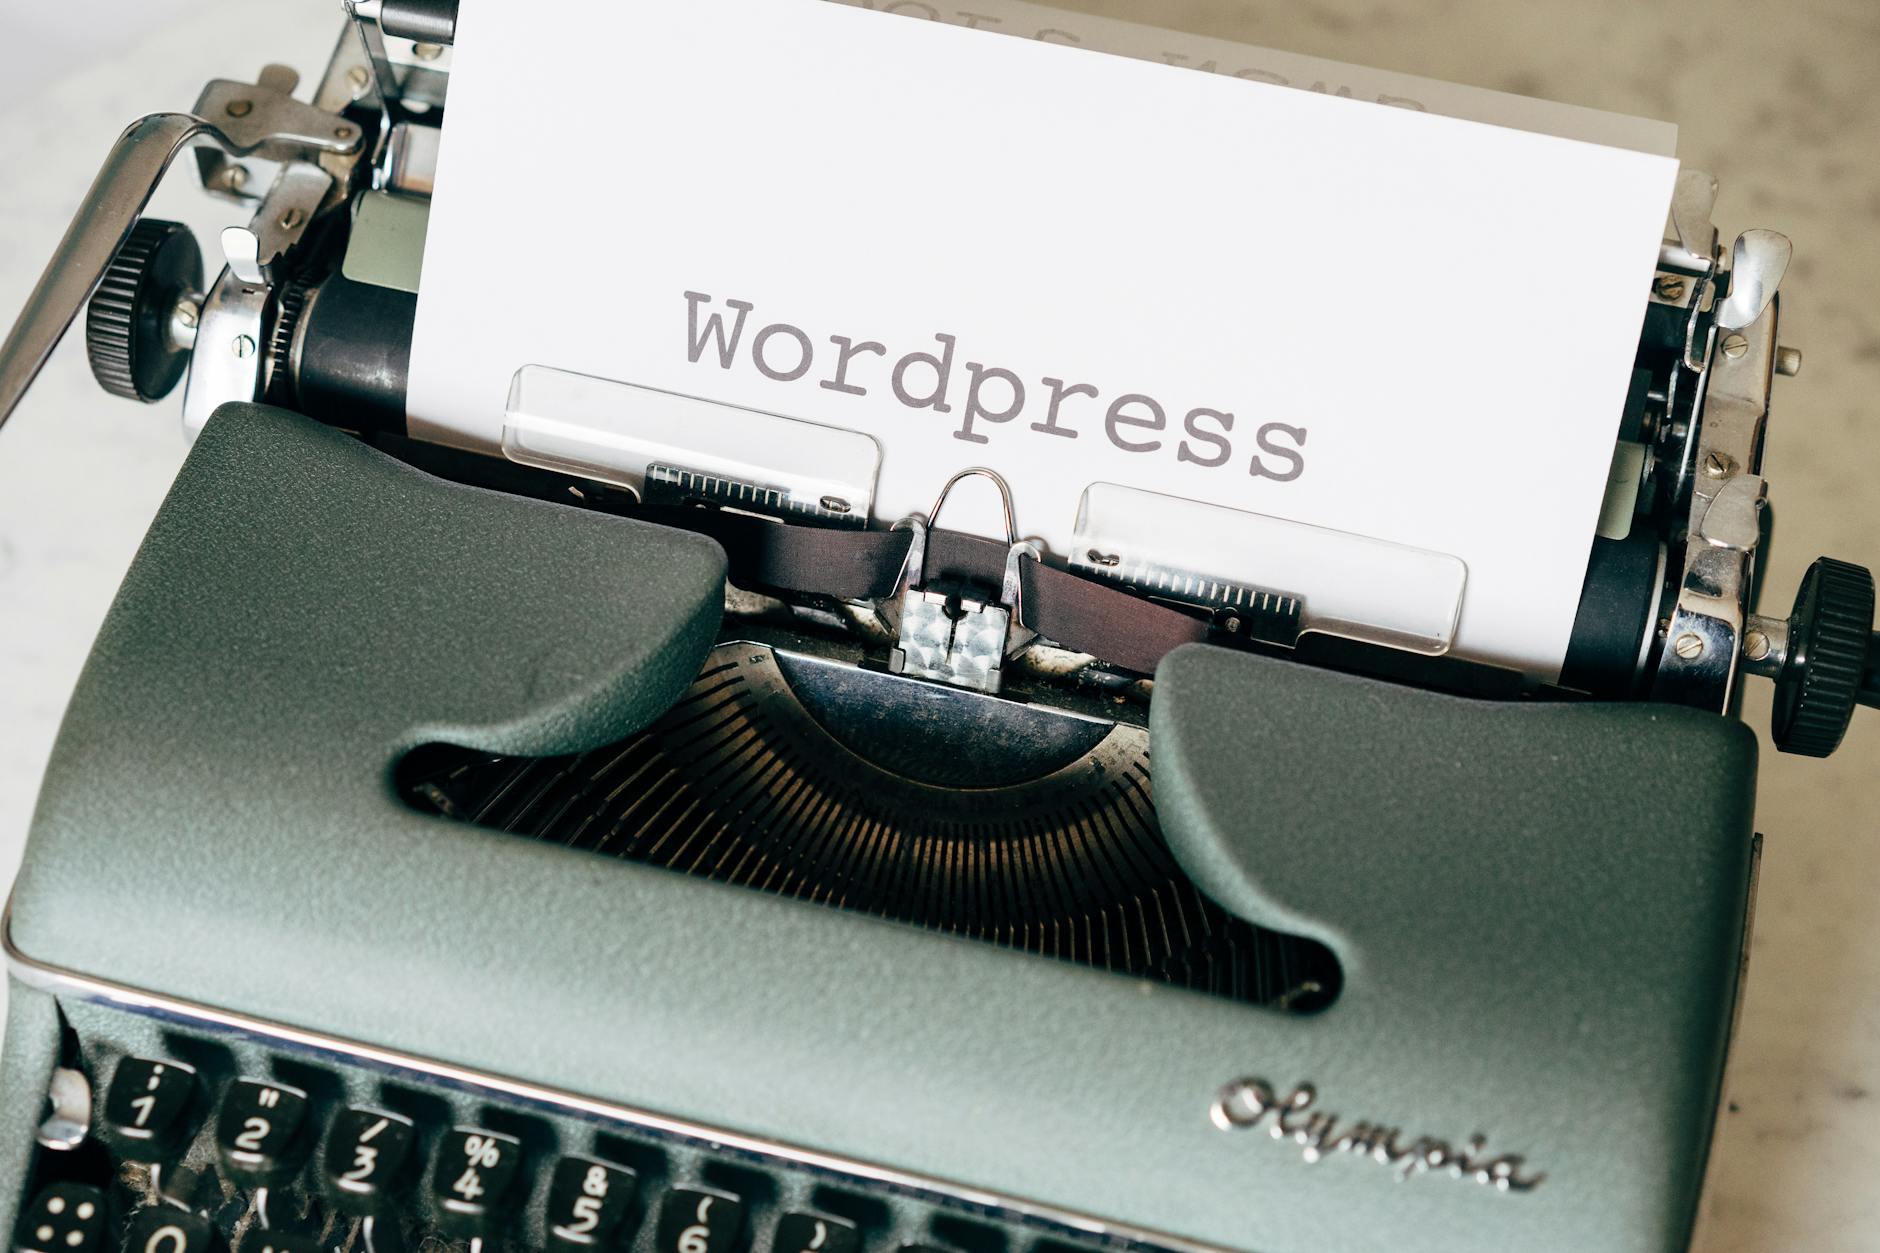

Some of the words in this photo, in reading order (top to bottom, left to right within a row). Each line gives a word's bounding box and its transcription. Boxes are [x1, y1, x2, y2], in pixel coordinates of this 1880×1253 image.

[684, 290, 1308, 482] Wordpress
[131, 1095, 155, 1126] 1
[235, 1116, 271, 1150] 2
[342, 1145, 378, 1181] 3
[464, 1134, 500, 1168] %
[453, 1167, 485, 1200] 4
[566, 1195, 603, 1233] 5
[677, 1225, 711, 1253] 6
